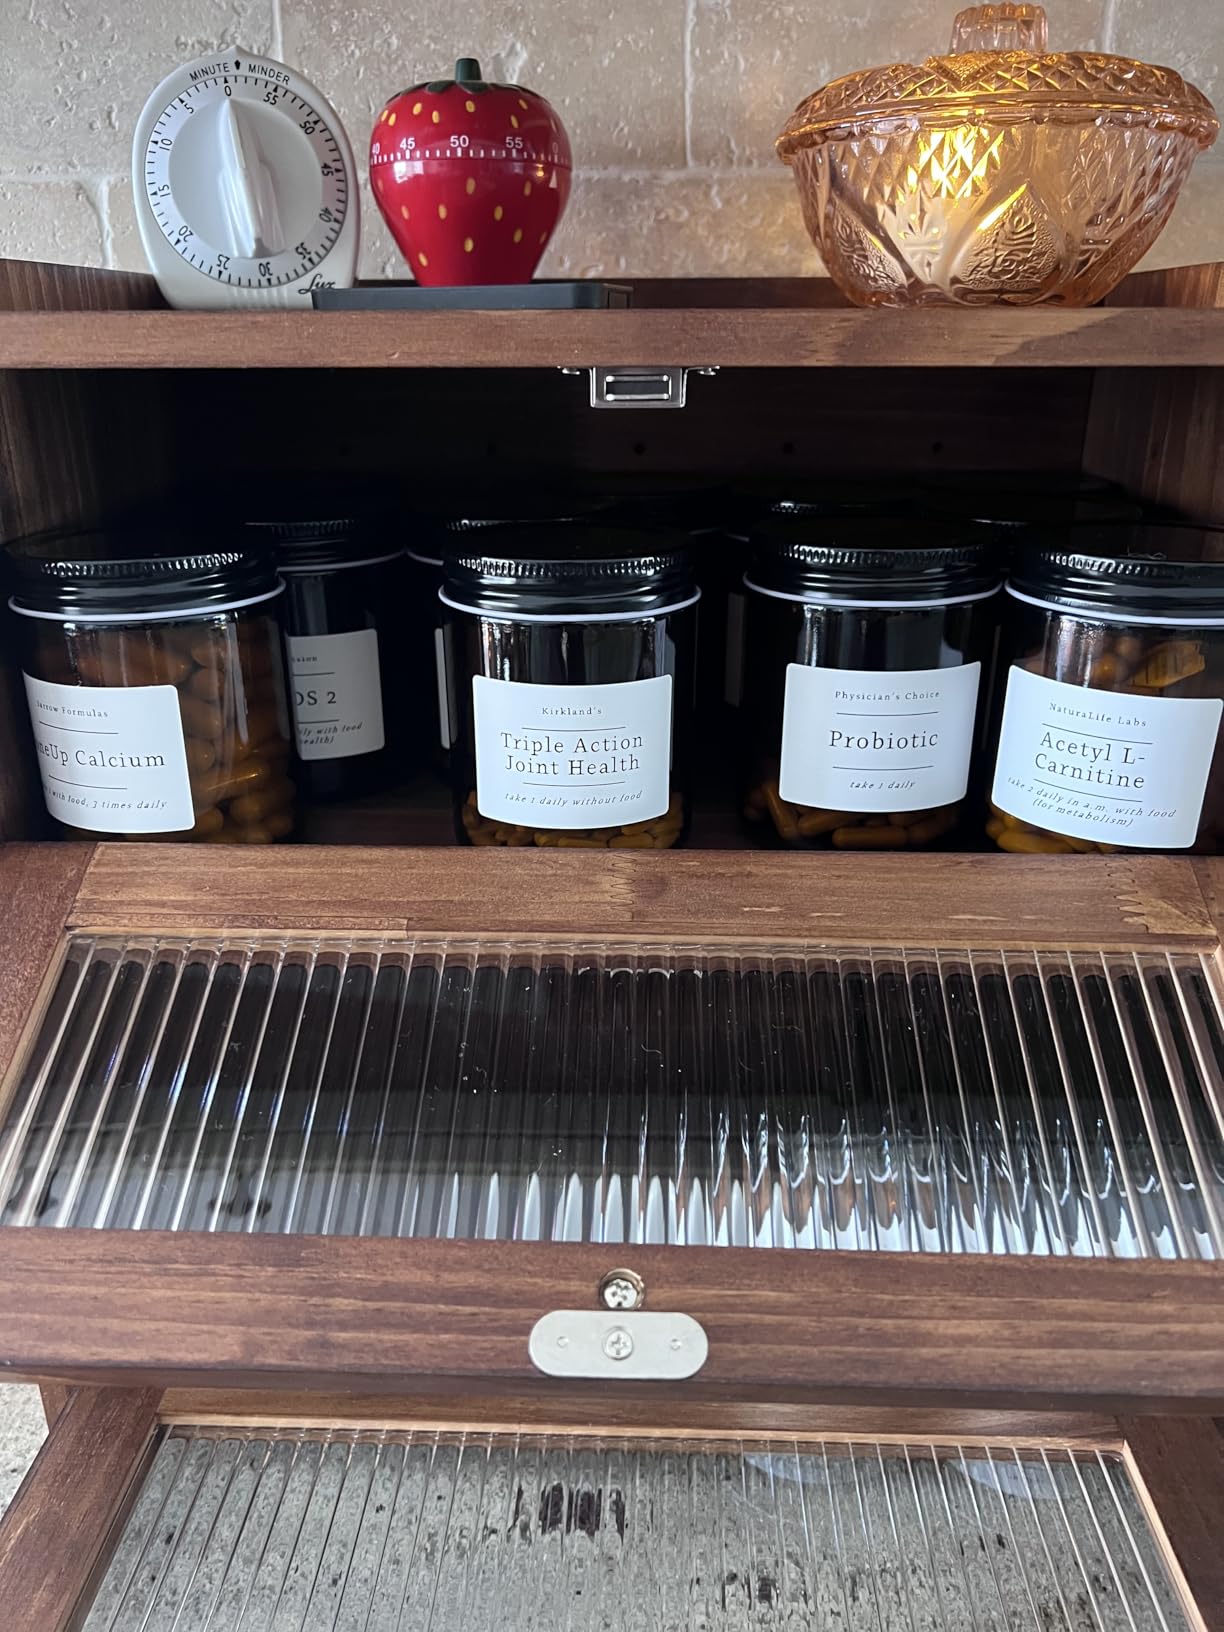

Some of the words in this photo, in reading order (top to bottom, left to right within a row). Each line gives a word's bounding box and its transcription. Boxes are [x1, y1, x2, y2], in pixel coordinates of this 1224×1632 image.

[189, 62, 230, 82] MINUTE
[248, 63, 290, 86] MINDER
[224, 85, 233, 97] 0
[263, 91, 280, 106] 55
[184, 103, 195, 115] 5
[299, 120, 315, 136] 50
[158, 138, 173, 151] 10
[399, 137, 416, 149] 45
[450, 135, 469, 148] 50
[505, 136, 524, 149] 55
[321, 162, 334, 177] 45
[158, 184, 171, 197] 15
[318, 207, 333, 223] 40
[178, 225, 194, 243] 20
[295, 241, 312, 260] 35
[216, 253, 231, 271] 25
[258, 262, 273, 278] 30
[326, 691, 337, 705] 2
[835, 690, 901, 702] Physician's
[905, 691, 940, 700] Choice
[61, 706, 109, 718] Formulas
[542, 707, 602, 716] Kirkland's
[1049, 702, 1112, 723] NaturaLife
[1117, 715, 1147, 728] Labs
[500, 732, 564, 756] Triple
[573, 735, 644, 754] Action
[828, 729, 939, 750] Probiotic
[1039, 731, 1112, 763] Acetyl
[1121, 747, 1146, 765] L-
[75, 750, 166, 768] Calcium
[505, 754, 559, 776] Joint
[568, 754, 641, 776] Health
[1035, 753, 1146, 789] Carnitine
[849, 780, 875, 790] take
[887, 780, 916, 790] daily
[92, 800, 98, 809] 3
[102, 800, 132, 809] times
[136, 799, 168, 810] daily
[505, 793, 527, 803] take
[539, 796, 568, 807] daily
[572, 795, 617, 806] without
[619, 790, 643, 803] food
[1007, 777, 1026, 789] take
[1036, 787, 1064, 803] daily
[1066, 796, 1079, 806] in
[1083, 801, 1108, 812] a.m.
[1115, 805, 1143, 817] with
[1147, 808, 1178, 819] food
[1032, 798, 1054, 811] (for
[1055, 805, 1134, 828] metabolism)
